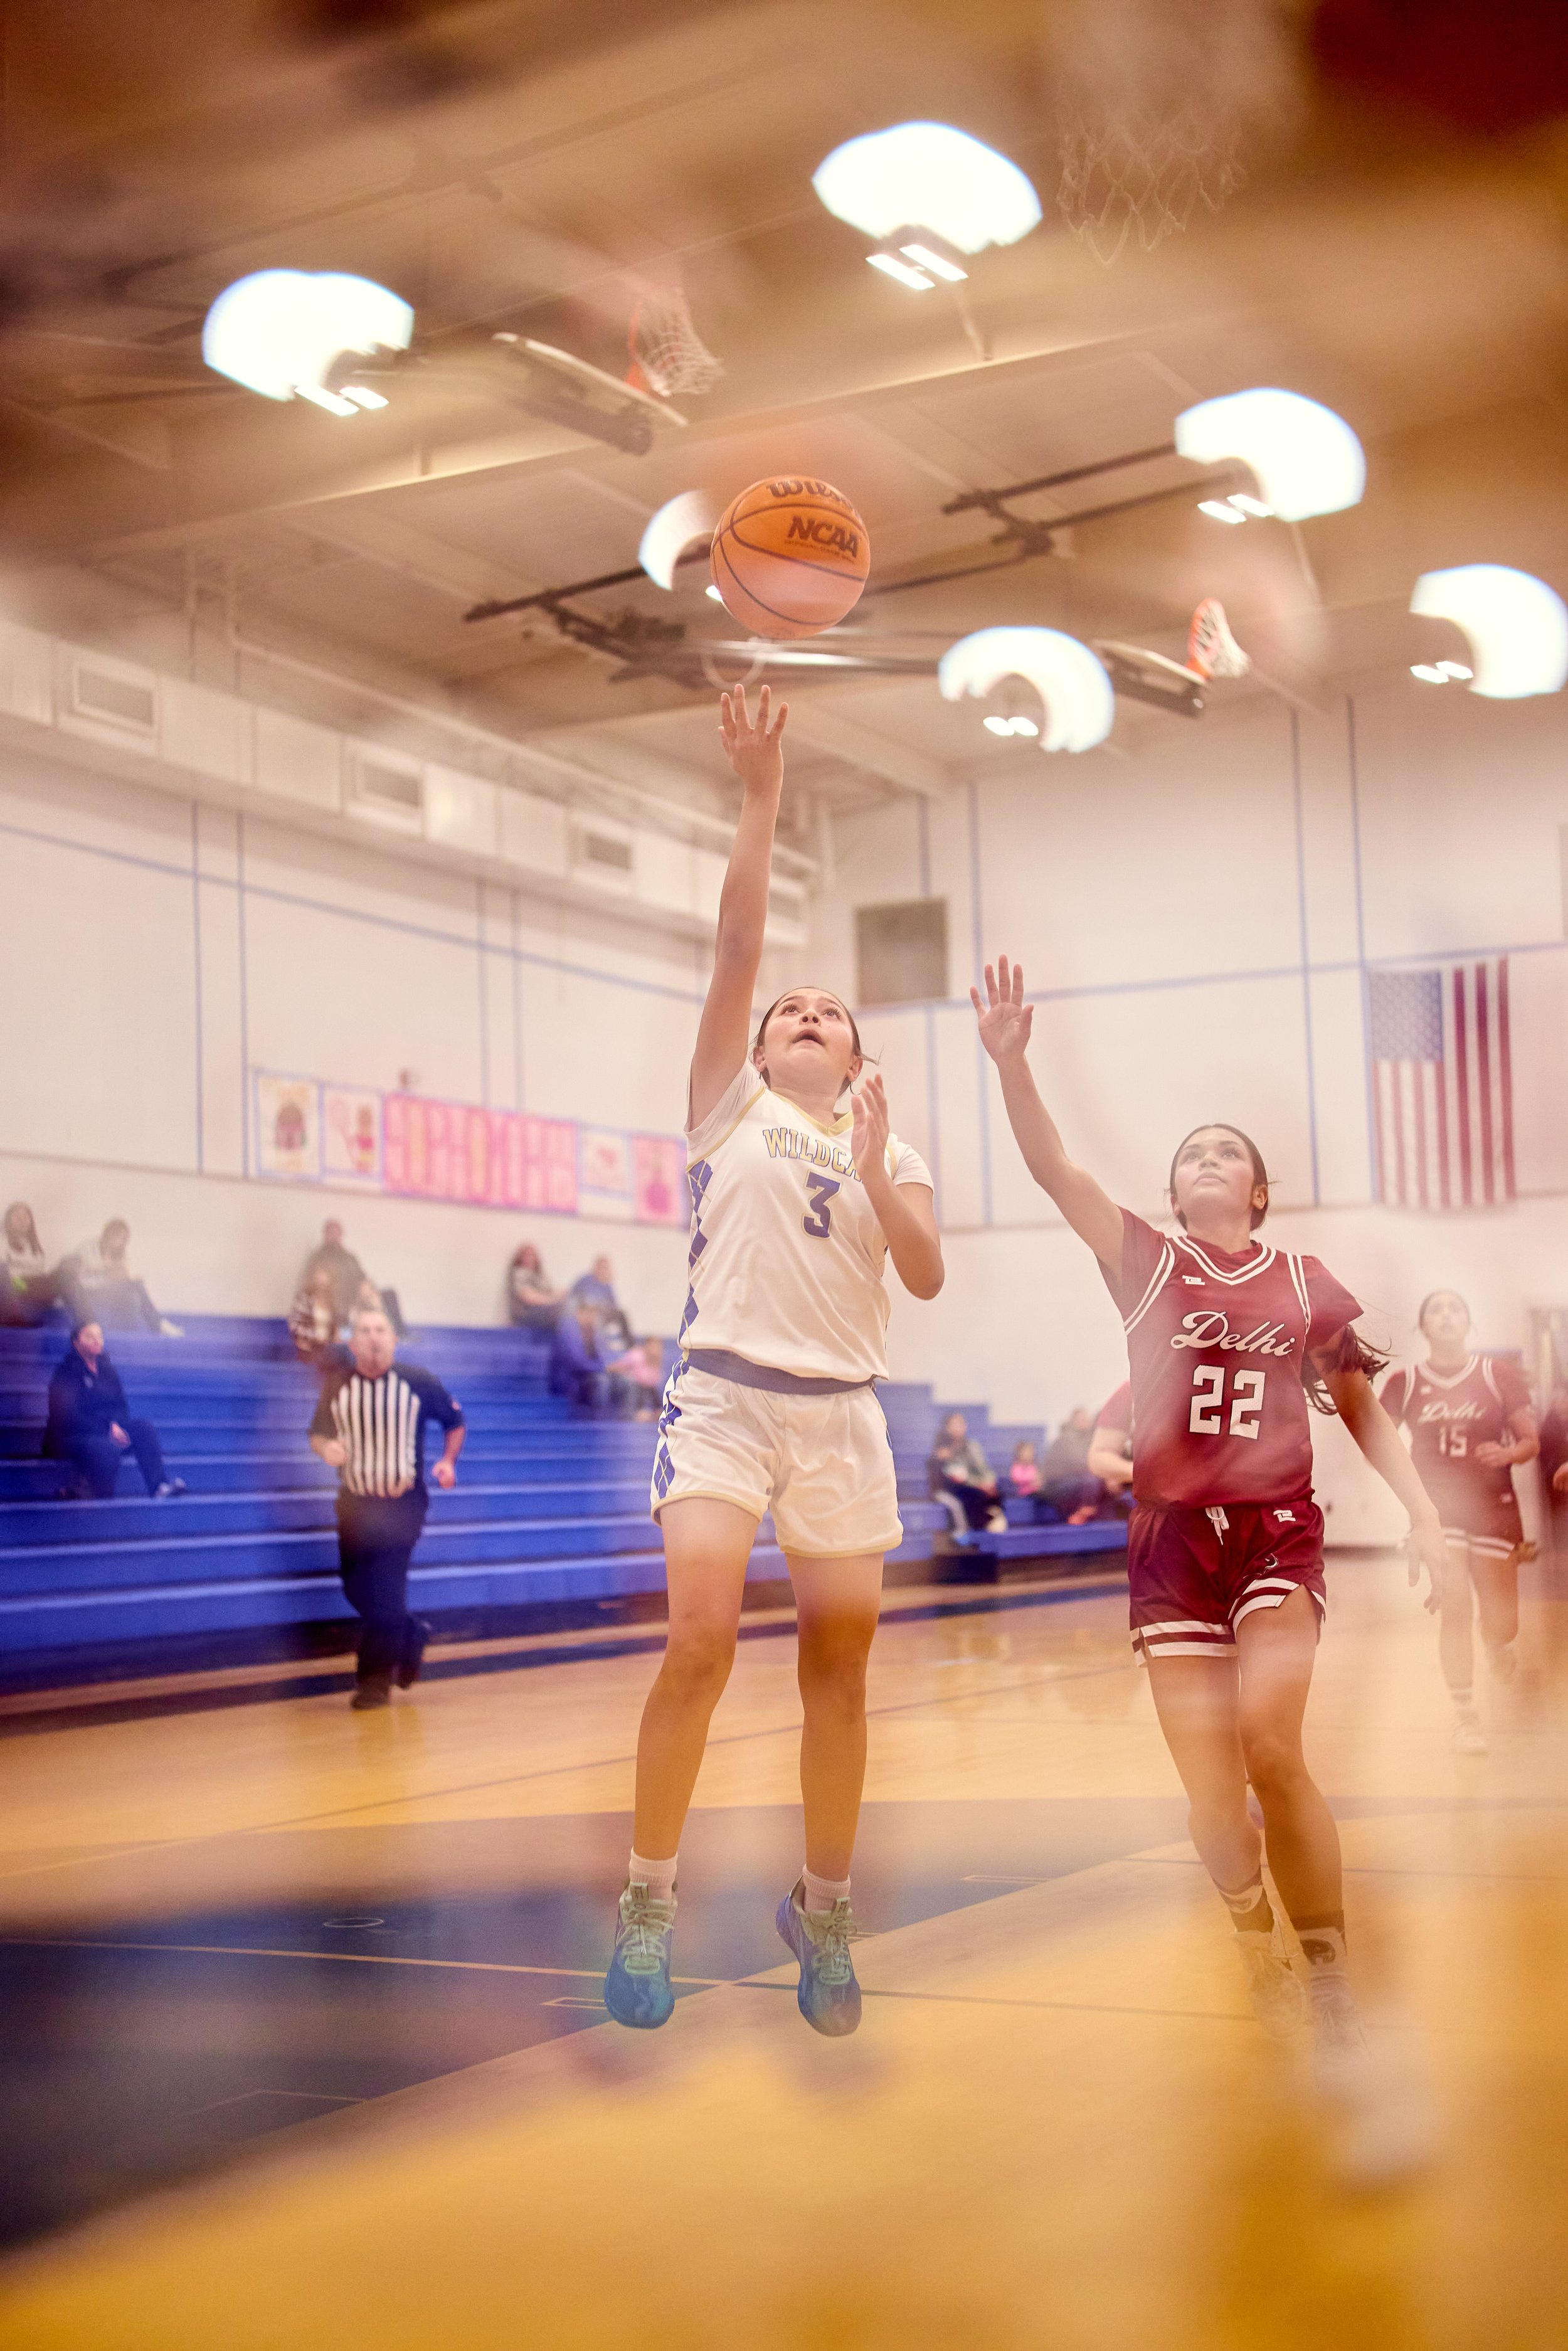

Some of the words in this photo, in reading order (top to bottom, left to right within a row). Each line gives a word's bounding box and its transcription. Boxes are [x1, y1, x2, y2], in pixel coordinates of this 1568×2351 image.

[787, 516, 859, 558] NCAA
[802, 1170, 842, 1239] 3
[1170, 1311, 1295, 1357] Delhi
[1189, 1365, 1266, 1440] 22
[1439, 1425, 1468, 1458] 15
